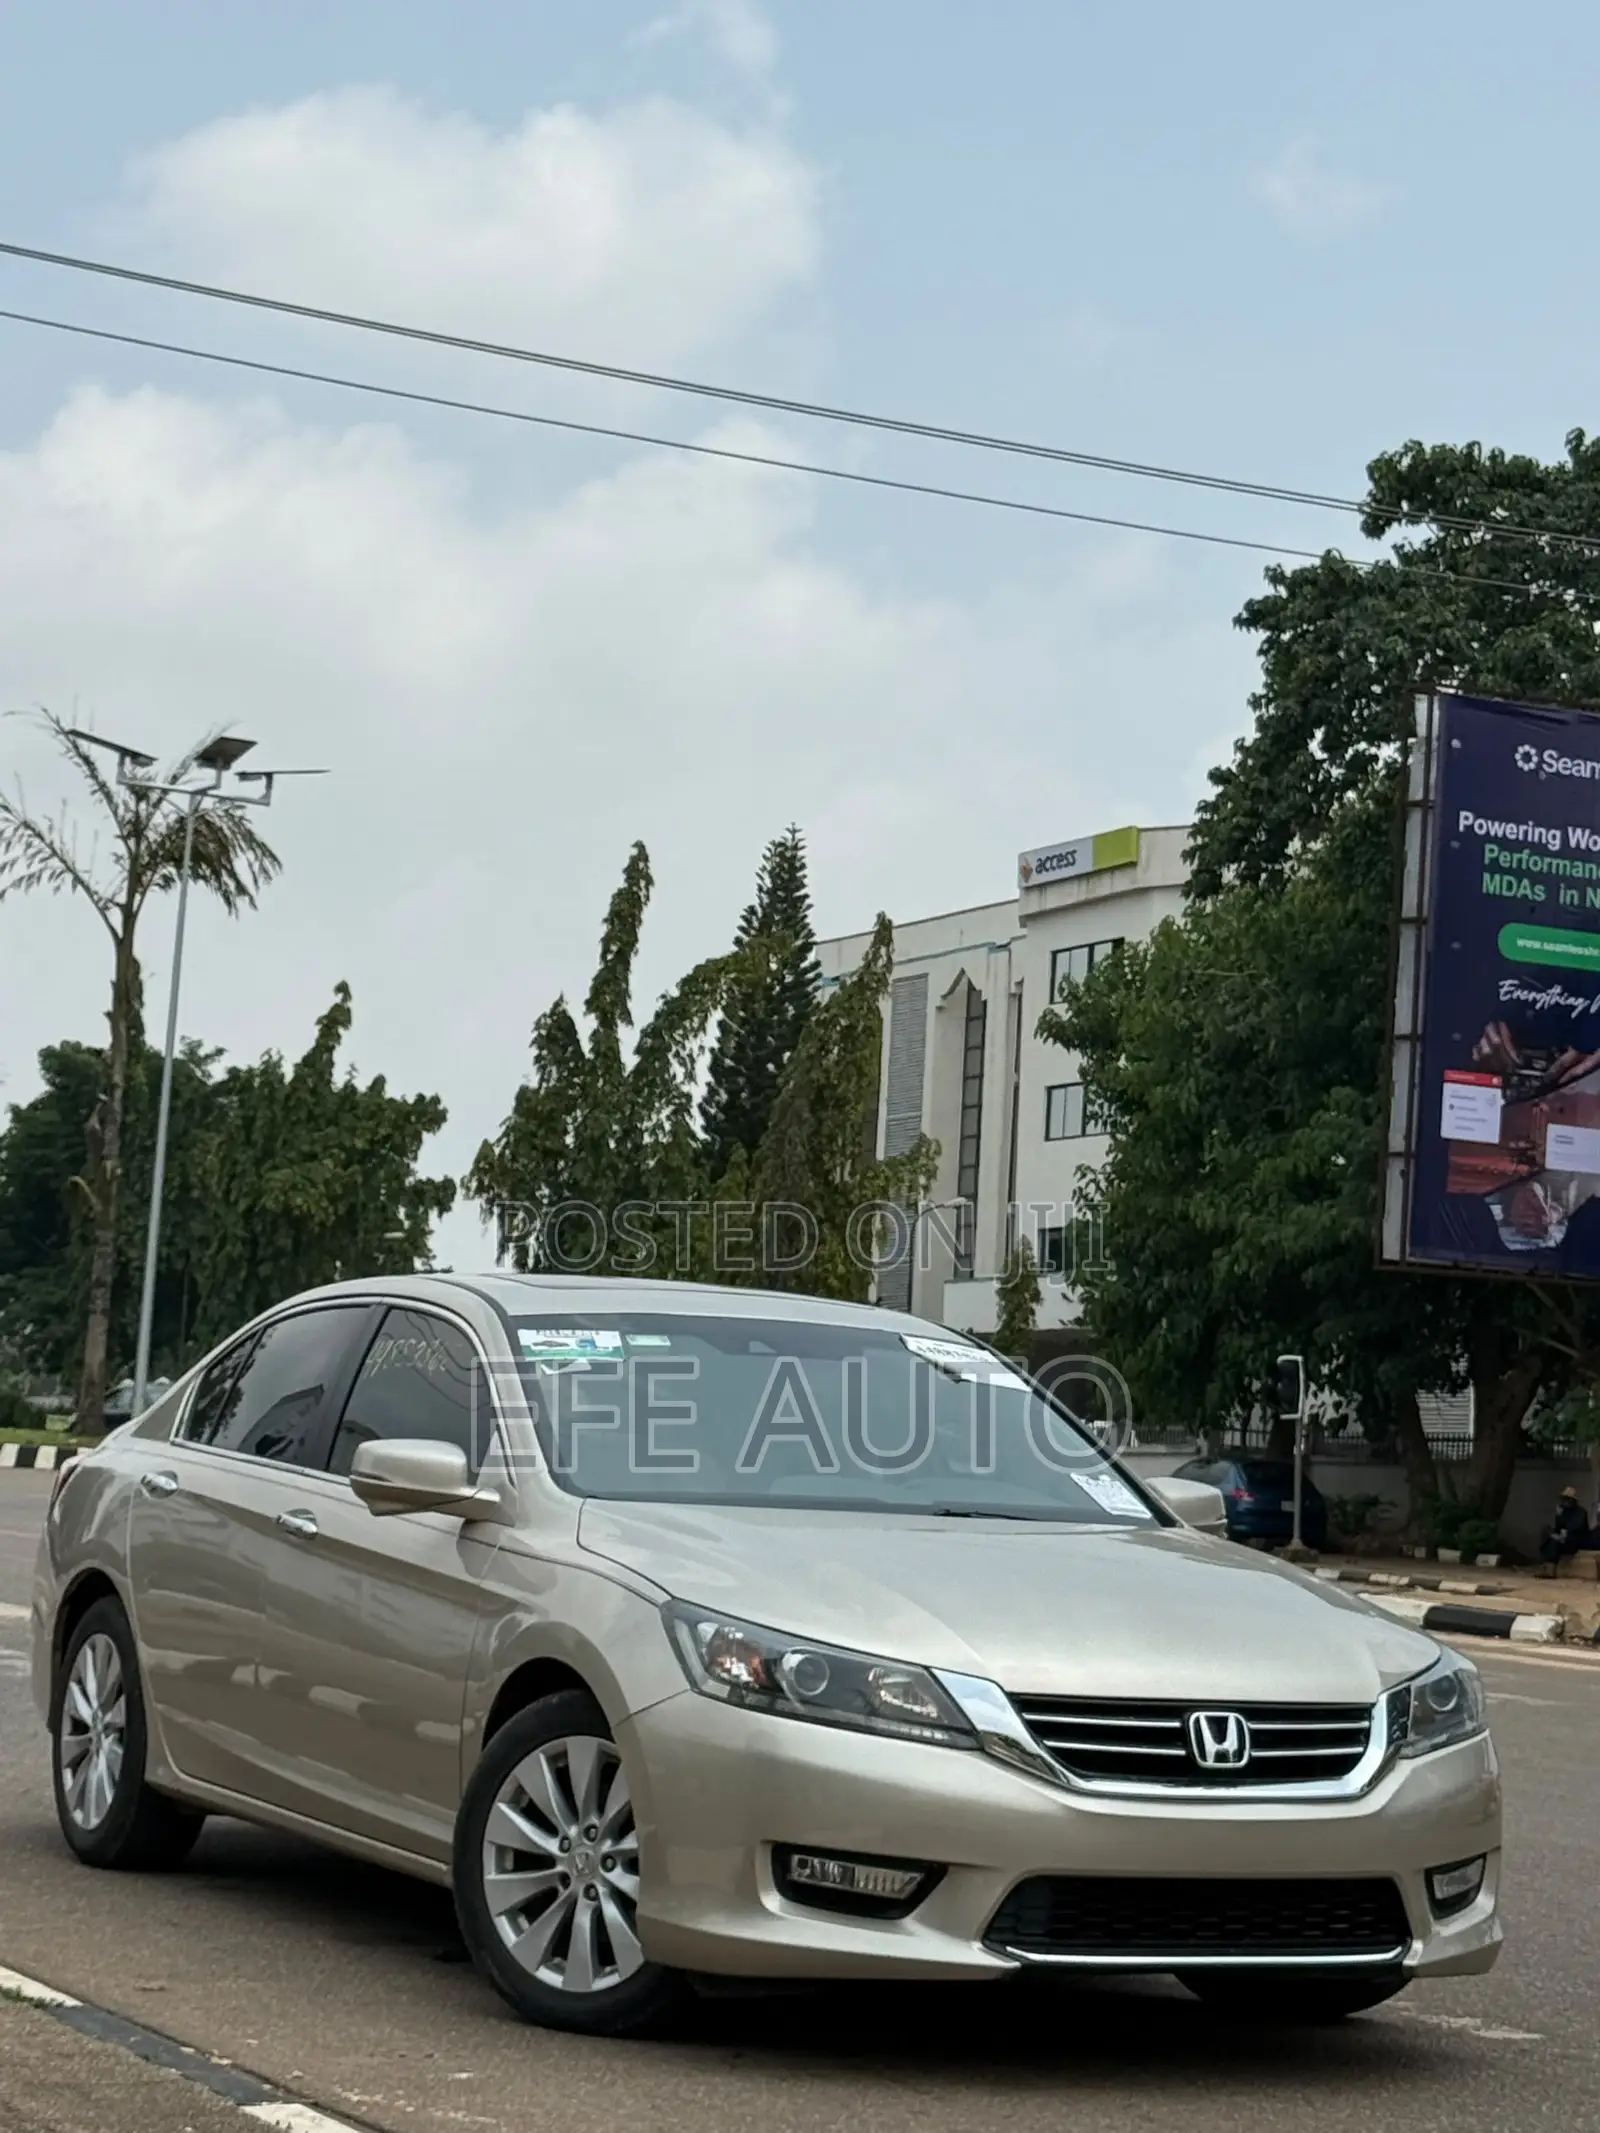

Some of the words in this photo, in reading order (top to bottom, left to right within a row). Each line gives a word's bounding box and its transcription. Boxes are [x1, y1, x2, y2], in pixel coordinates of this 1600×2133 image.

[1459, 810, 1561, 851] Powering
[1035, 850, 1078, 874] access
[1484, 843, 1600, 880] Performan
[1482, 872, 1546, 901] MDAs
[1559, 883, 1579, 907] in
[1498, 979, 1591, 1019] Everything
